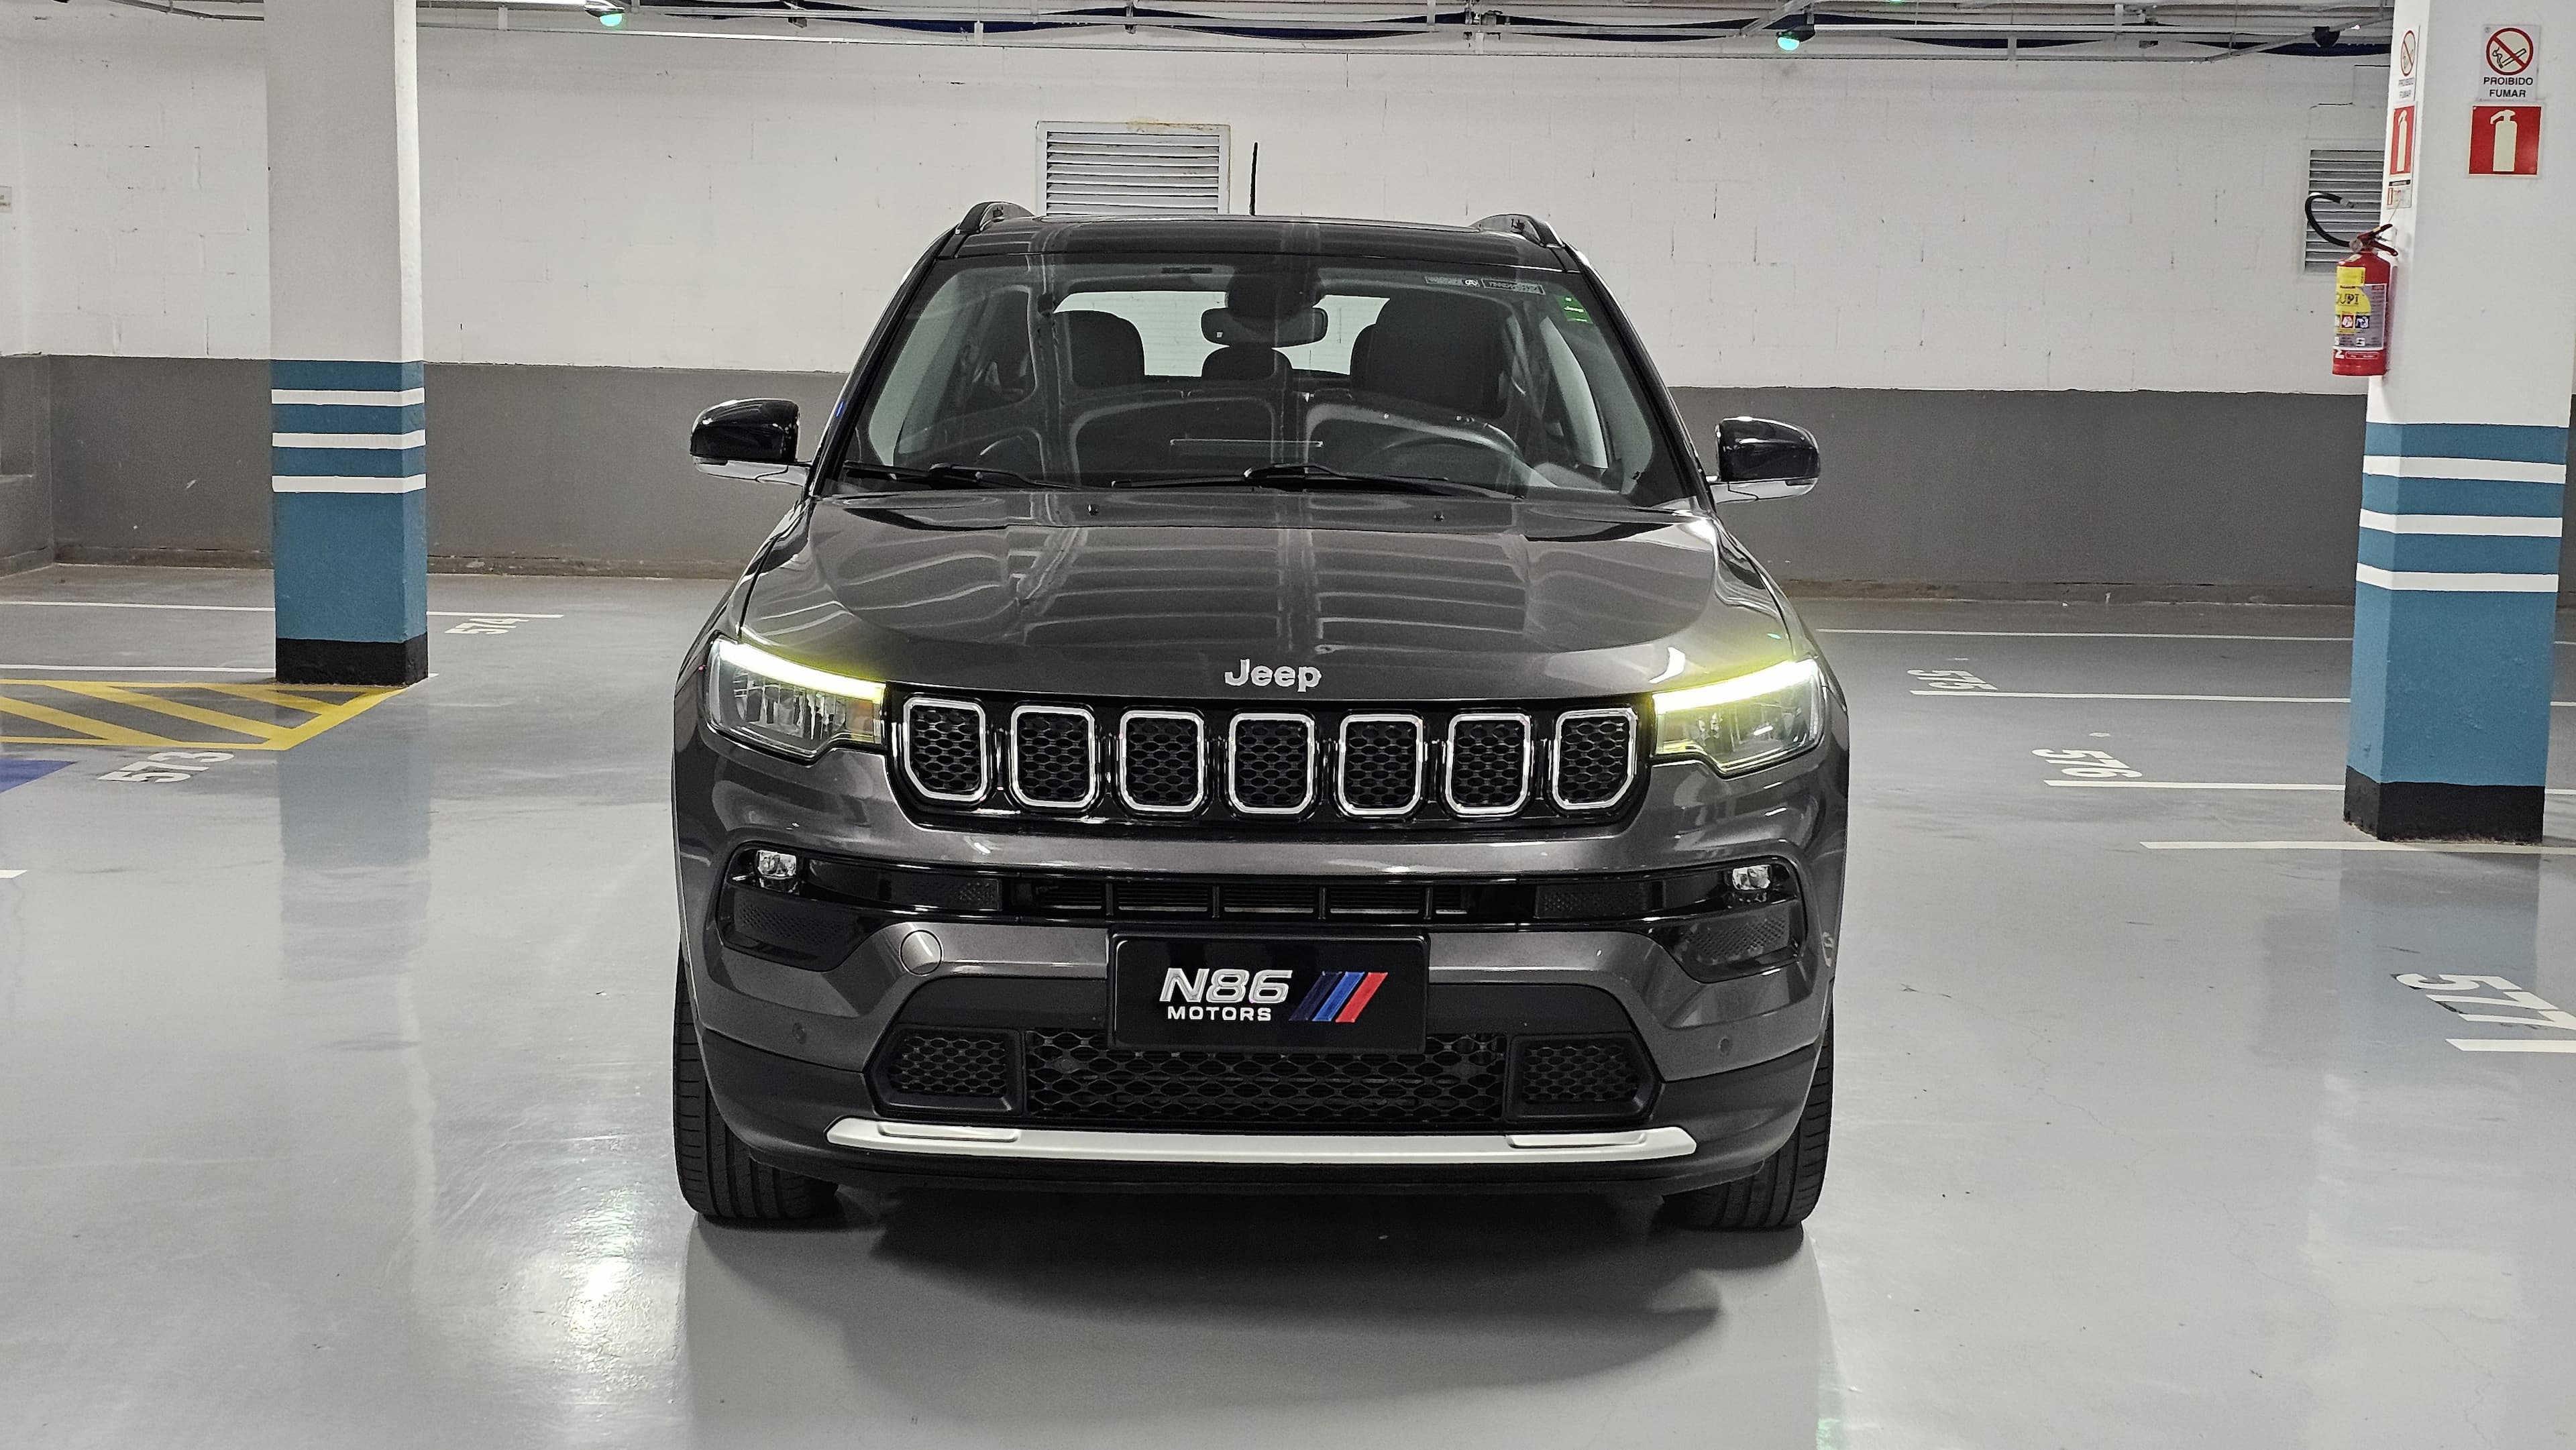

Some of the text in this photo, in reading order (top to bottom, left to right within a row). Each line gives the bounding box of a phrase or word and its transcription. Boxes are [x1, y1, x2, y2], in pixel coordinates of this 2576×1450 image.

[2483, 76, 2534, 87] PROIBIDO
[2489, 89, 2526, 98] FUMAR
[444, 618, 529, 634] 574
[1224, 658, 1322, 693] Jeep
[1907, 669, 1998, 691] 575
[97, 751, 235, 783] 573
[2031, 748, 2143, 778] 576
[1159, 967, 1293, 1004] N86
[1167, 1006, 1272, 1021] MOTORS
[2396, 972, 2576, 1031] 577
